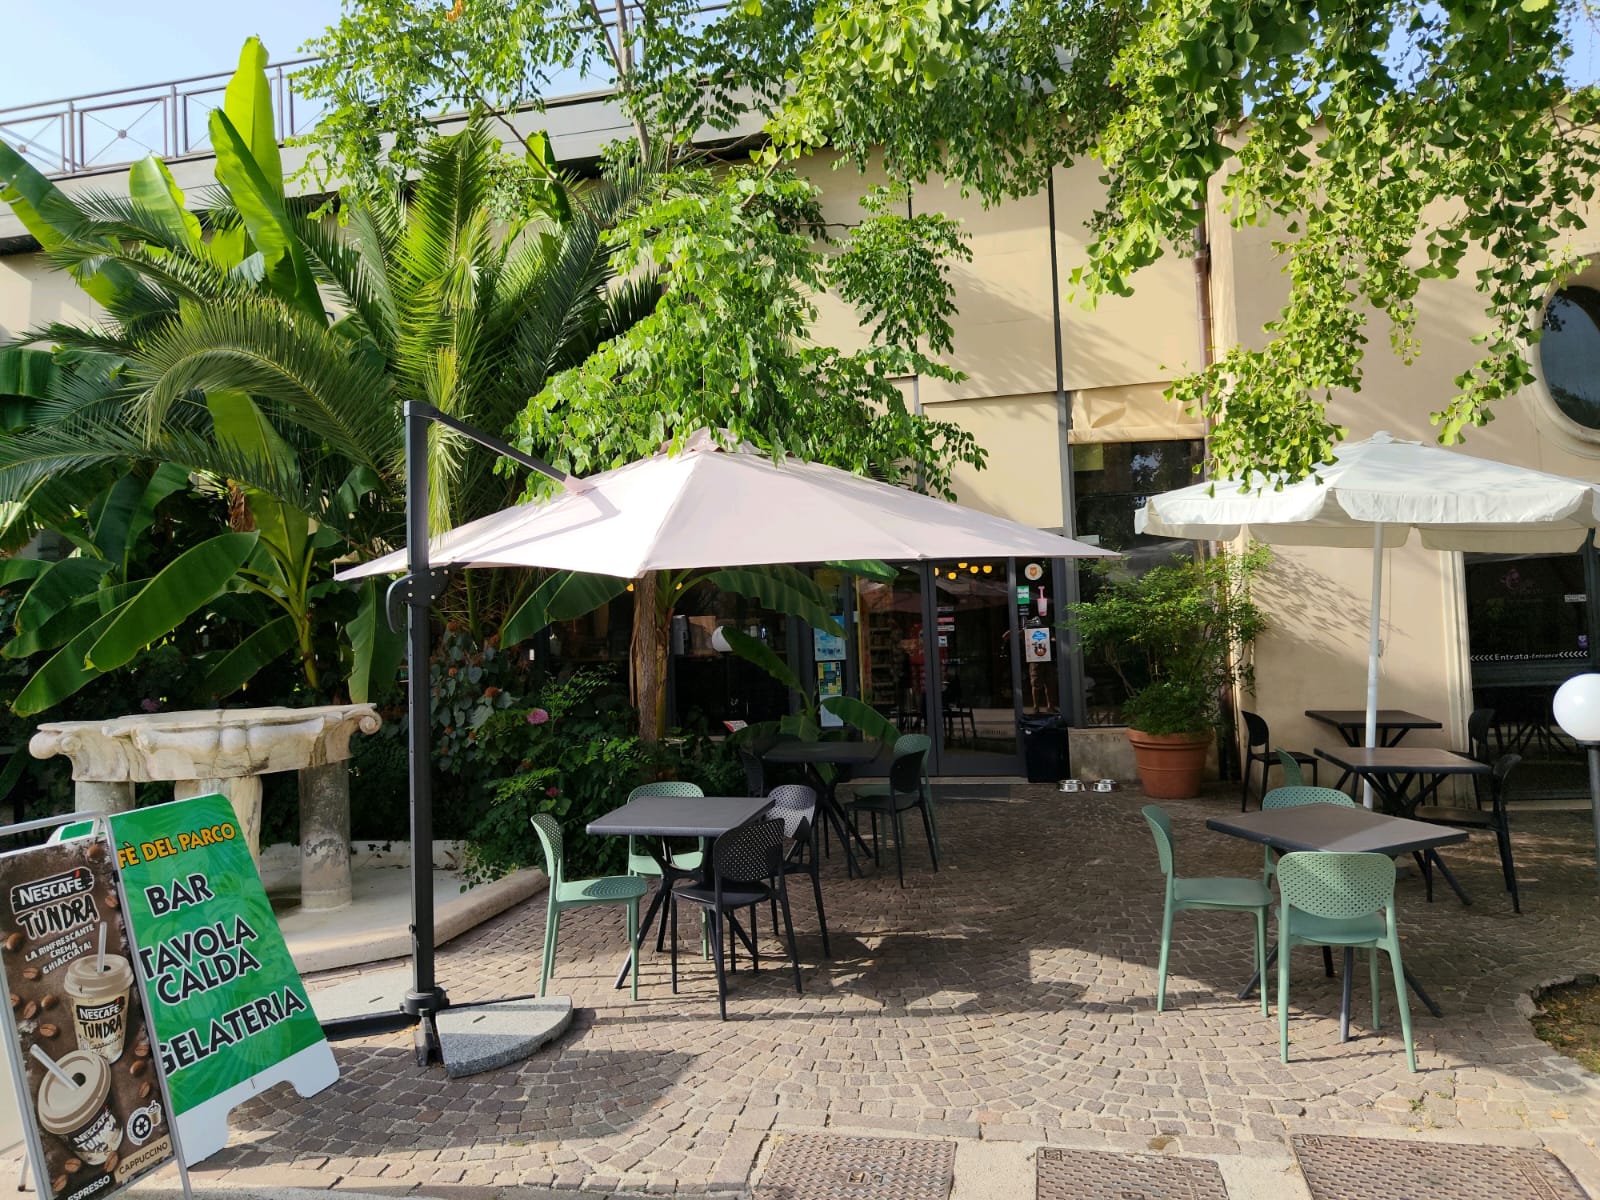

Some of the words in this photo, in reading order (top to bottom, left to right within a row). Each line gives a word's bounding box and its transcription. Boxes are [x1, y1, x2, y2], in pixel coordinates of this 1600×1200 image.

[1494, 653, 1529, 661] Entrata
[140, 836, 178, 862] DEL
[177, 822, 236, 853] PARCO
[144, 873, 215, 917] BAR
[16, 893, 100, 940] TUNDRA
[25, 950, 38, 962] LA
[38, 923, 95, 955] RINFRESCANTE
[42, 941, 92, 974] GHIACCIATA!
[50, 941, 78, 958] CREMA
[138, 914, 258, 981] TAVOLA
[156, 946, 262, 1006] CALDA
[79, 1014, 122, 1039] TUNDRA
[160, 986, 307, 1077] GELATERIA
[118, 1141, 169, 1175] CAPPUCCINO
